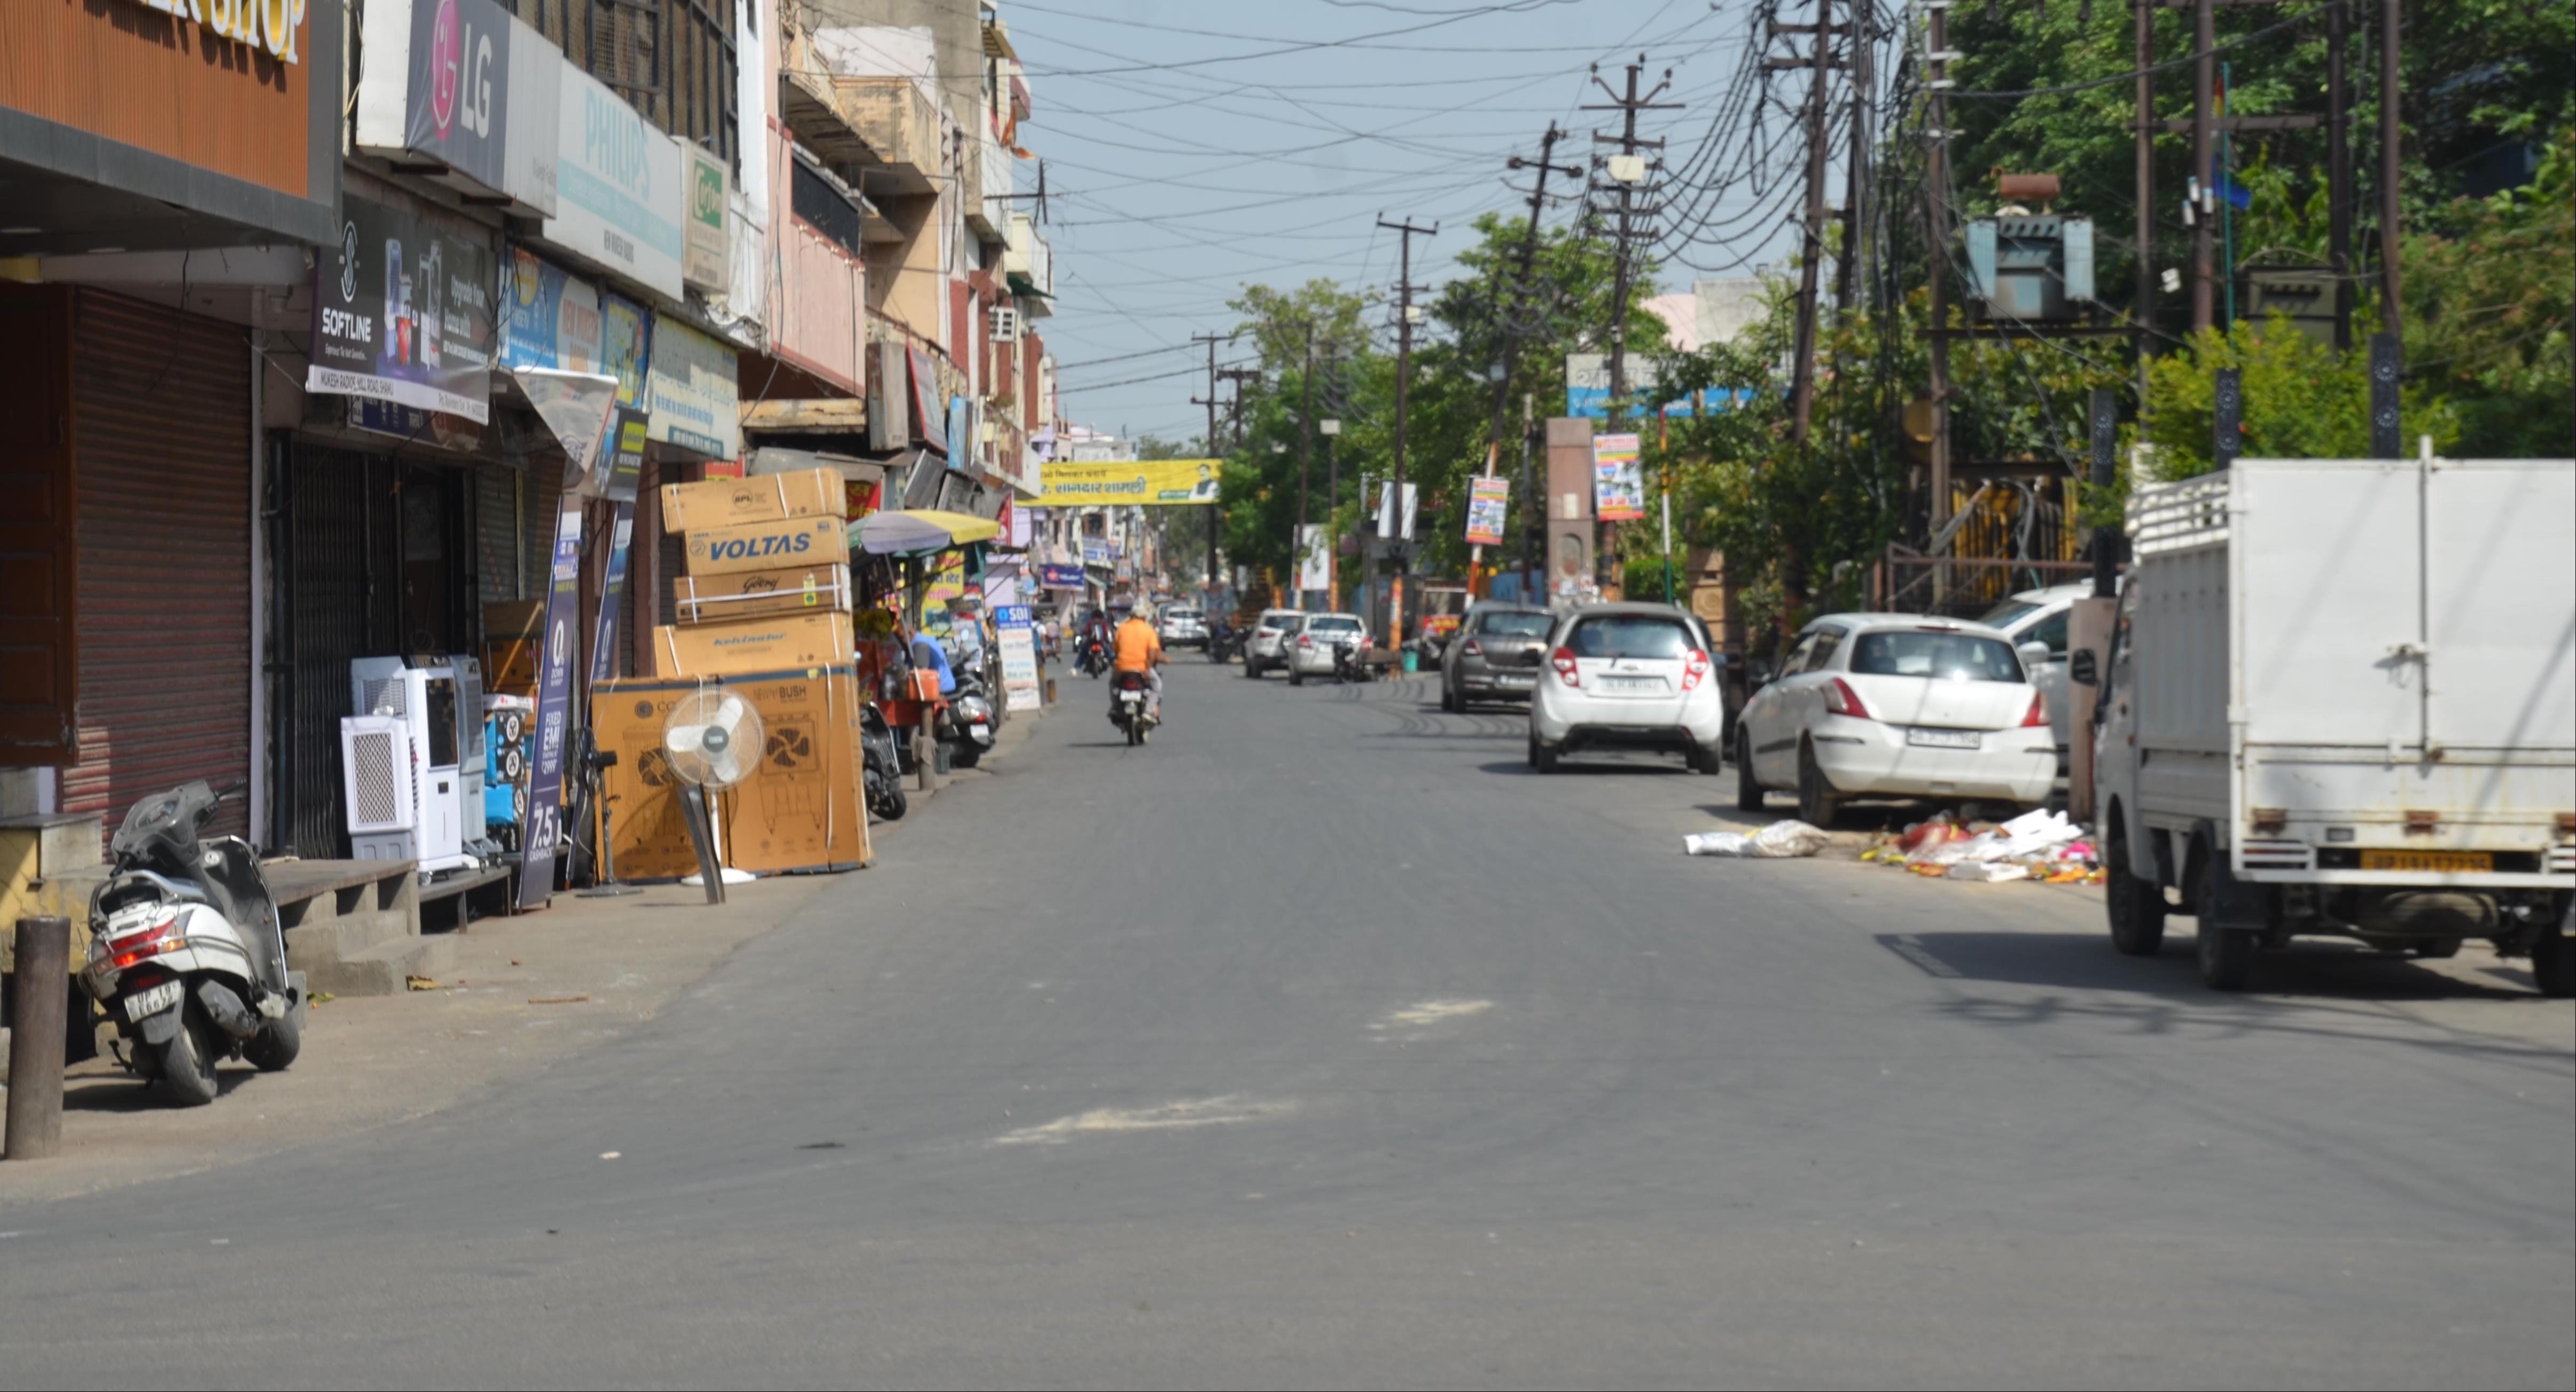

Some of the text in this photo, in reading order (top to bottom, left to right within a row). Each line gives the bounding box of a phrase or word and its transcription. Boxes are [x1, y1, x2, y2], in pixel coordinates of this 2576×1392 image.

[460, 22, 492, 139] LG
[587, 86, 651, 203] PHILIPS
[322, 307, 371, 343] SOFTLINE
[321, 371, 339, 387] MUKESH
[1056, 483, 1102, 494] शानदार
[1105, 476, 1146, 494] शामली
[711, 532, 811, 561] VOLTAS
[743, 576, 780, 593] Godrej
[779, 685, 806, 698] BUSH
[545, 711, 561, 727] FIXED
[543, 726, 560, 750] EMI
[137, 991, 151, 1003] UP
